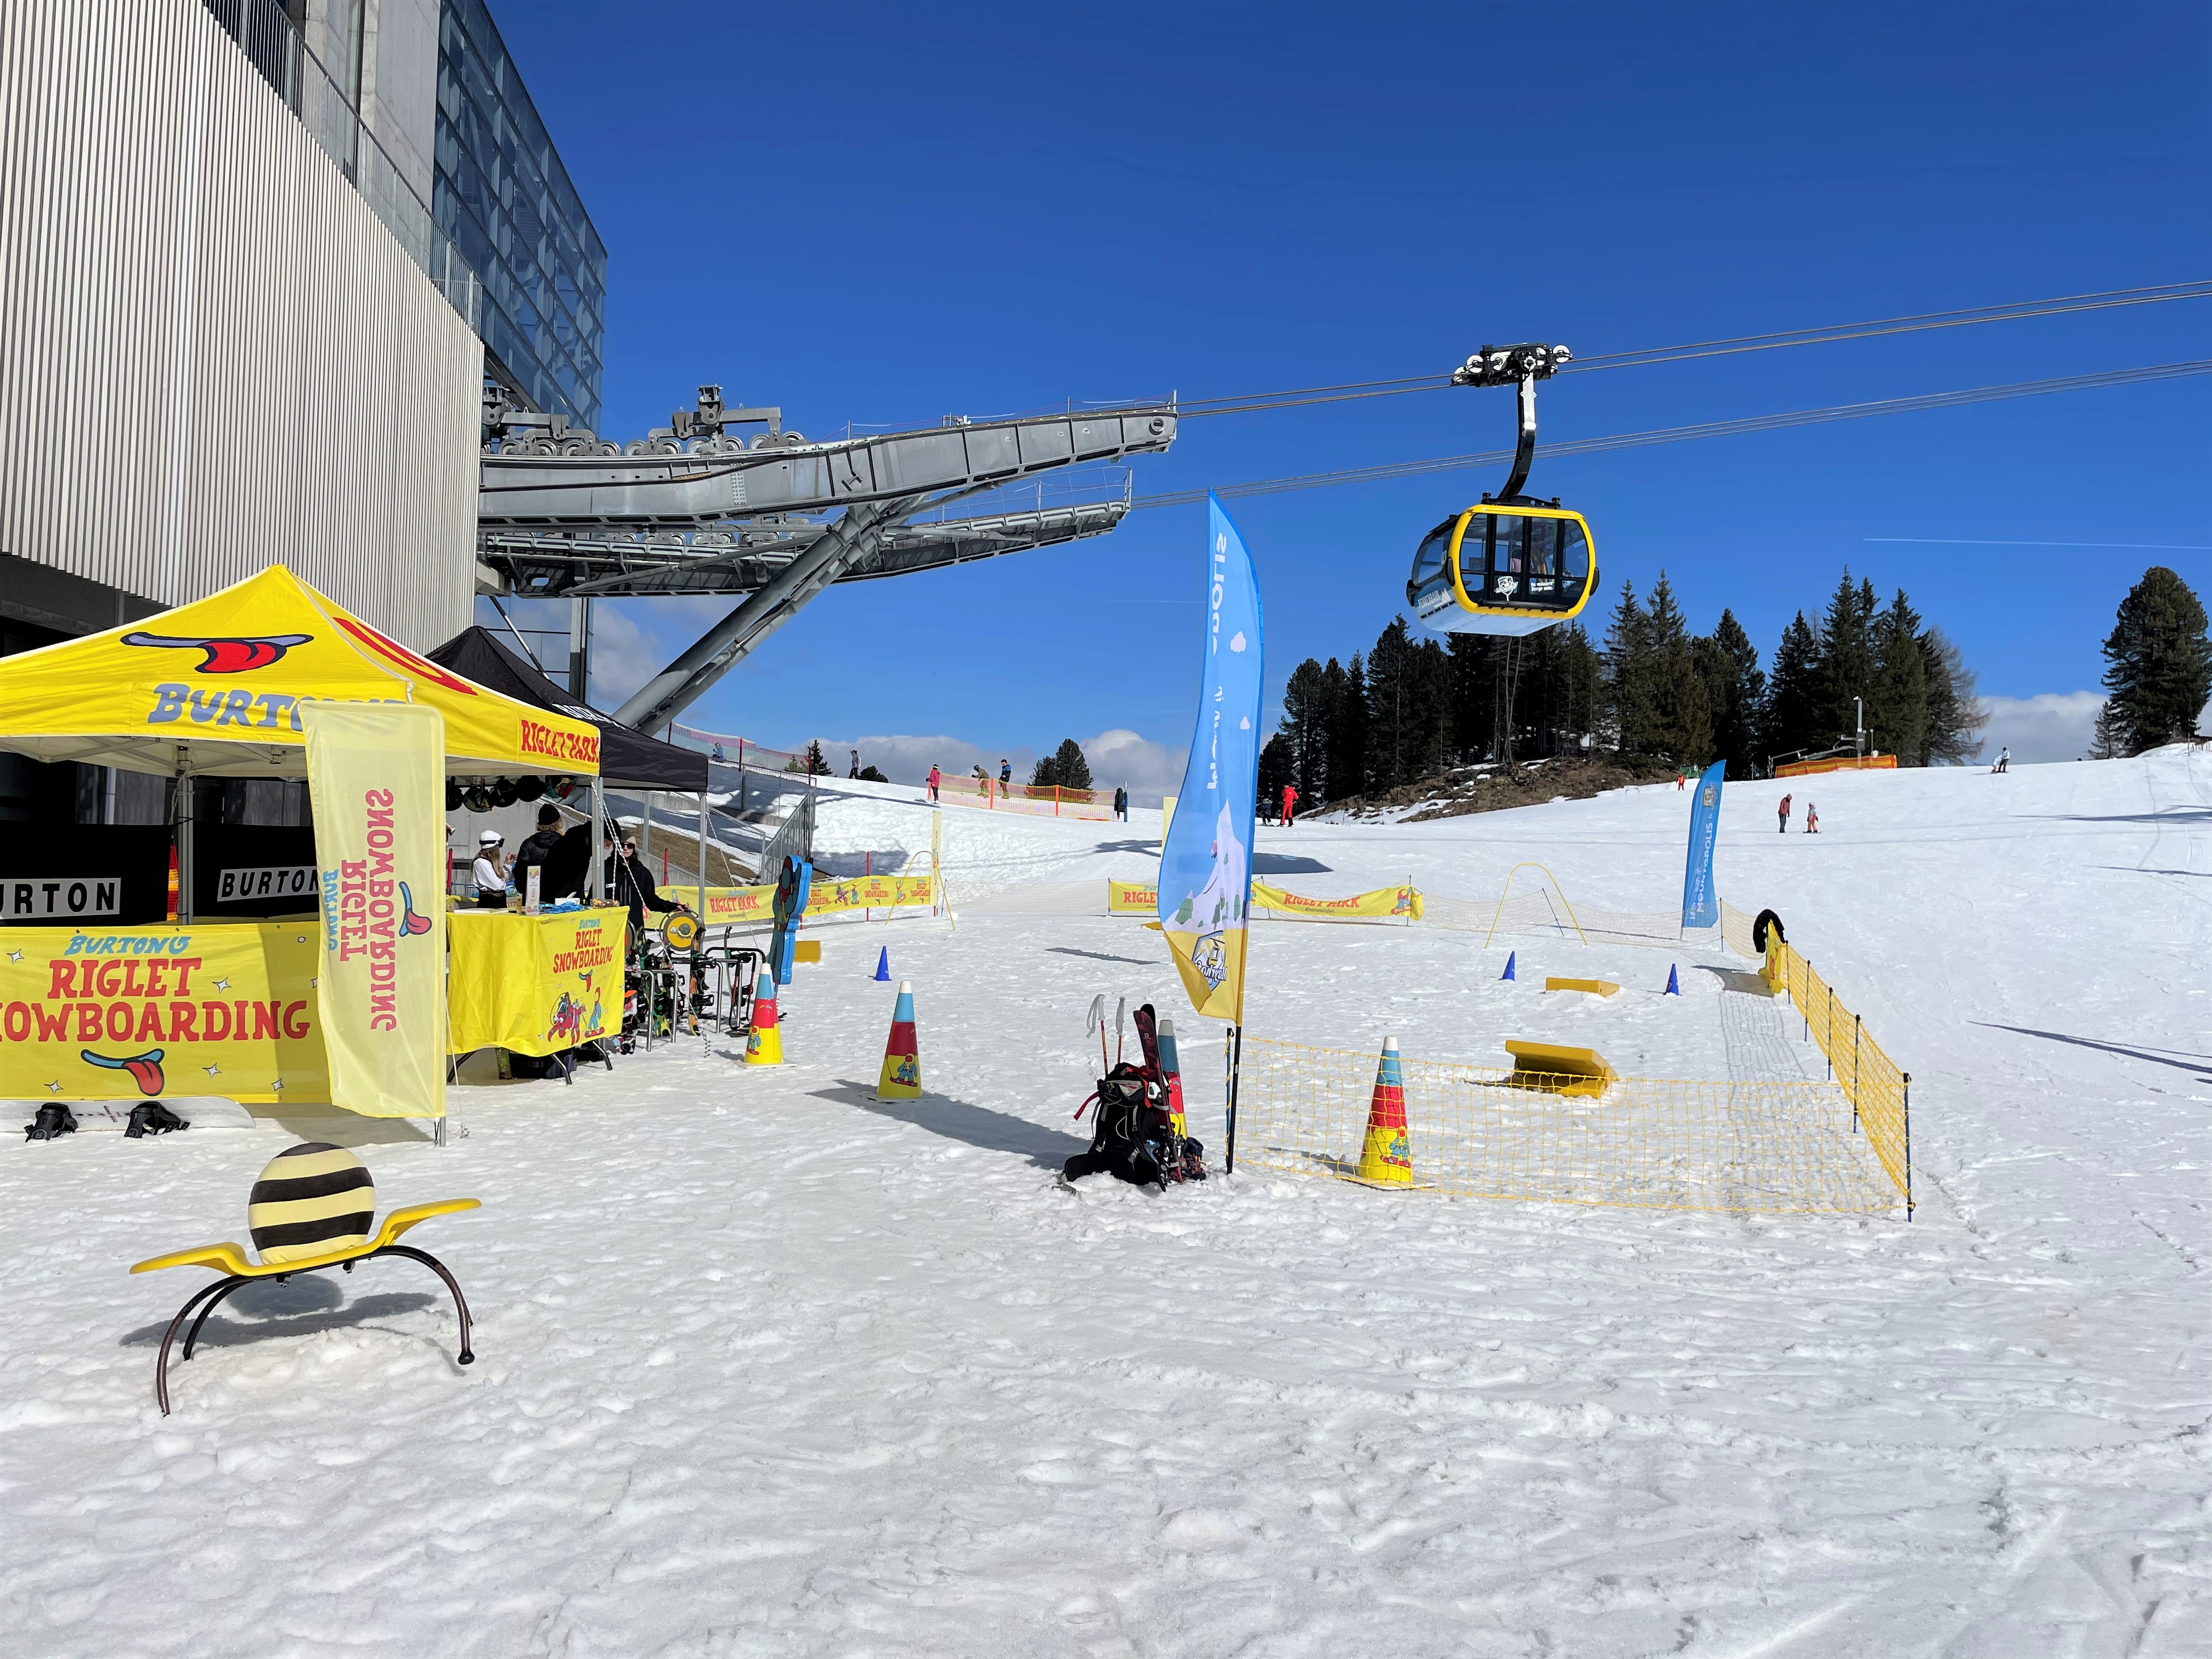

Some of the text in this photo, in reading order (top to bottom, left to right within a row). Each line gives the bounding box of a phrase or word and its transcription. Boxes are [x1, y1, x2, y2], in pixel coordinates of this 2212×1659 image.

[221, 869, 319, 898] BURTON
[1124, 891, 1158, 904] RIGLE
[0, 882, 115, 915] RTON
[709, 897, 737, 913] RIGLET
[575, 928, 602, 950] RIGLET
[47, 957, 202, 999] RIGLET
[0, 1000, 311, 1042] OWBOARDING
